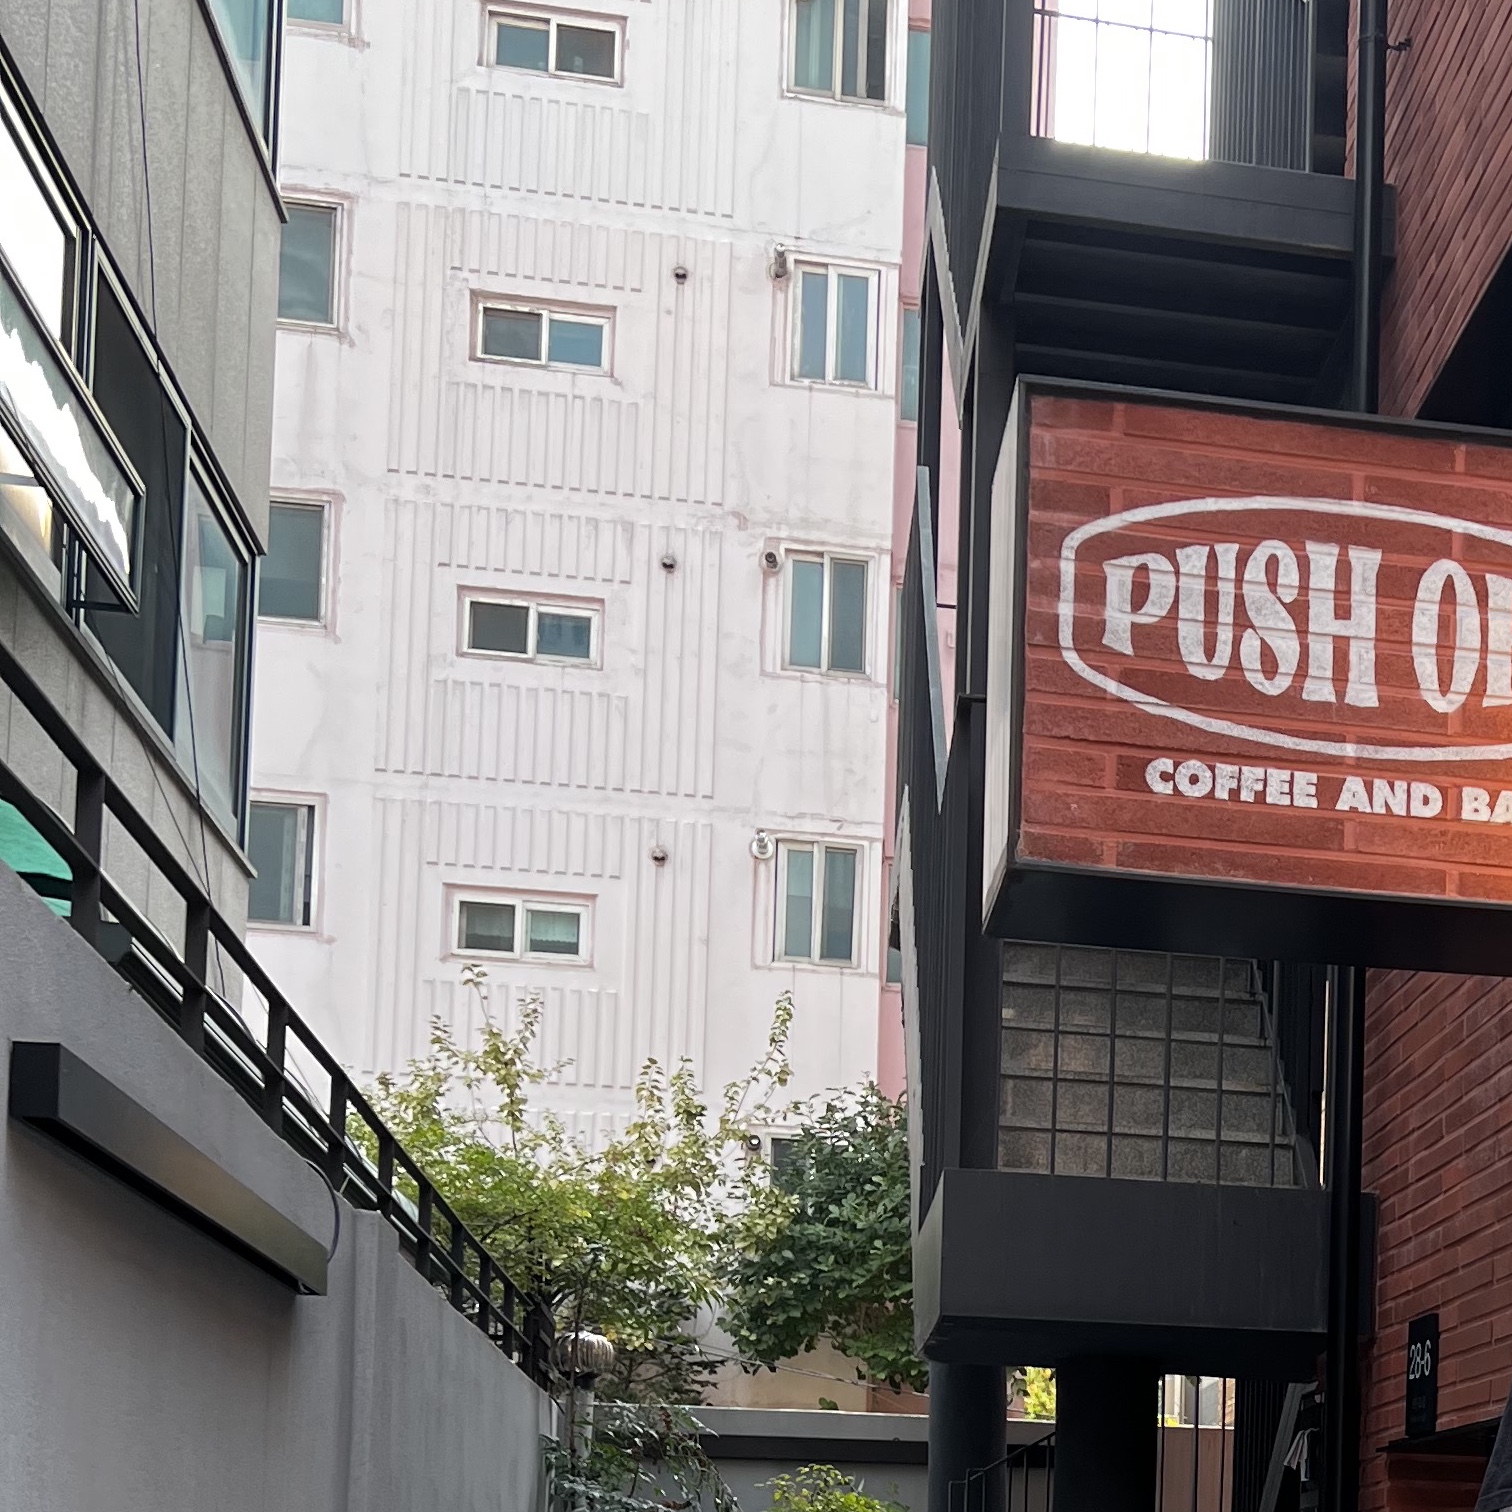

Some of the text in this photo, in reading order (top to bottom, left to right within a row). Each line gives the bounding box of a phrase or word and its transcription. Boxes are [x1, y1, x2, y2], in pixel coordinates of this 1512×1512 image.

[1102, 539, 1383, 708] PUSH
[1146, 756, 1319, 810] COFFEE
[1334, 776, 1443, 819] AND
[1408, 1339, 1432, 1380] 28-6
